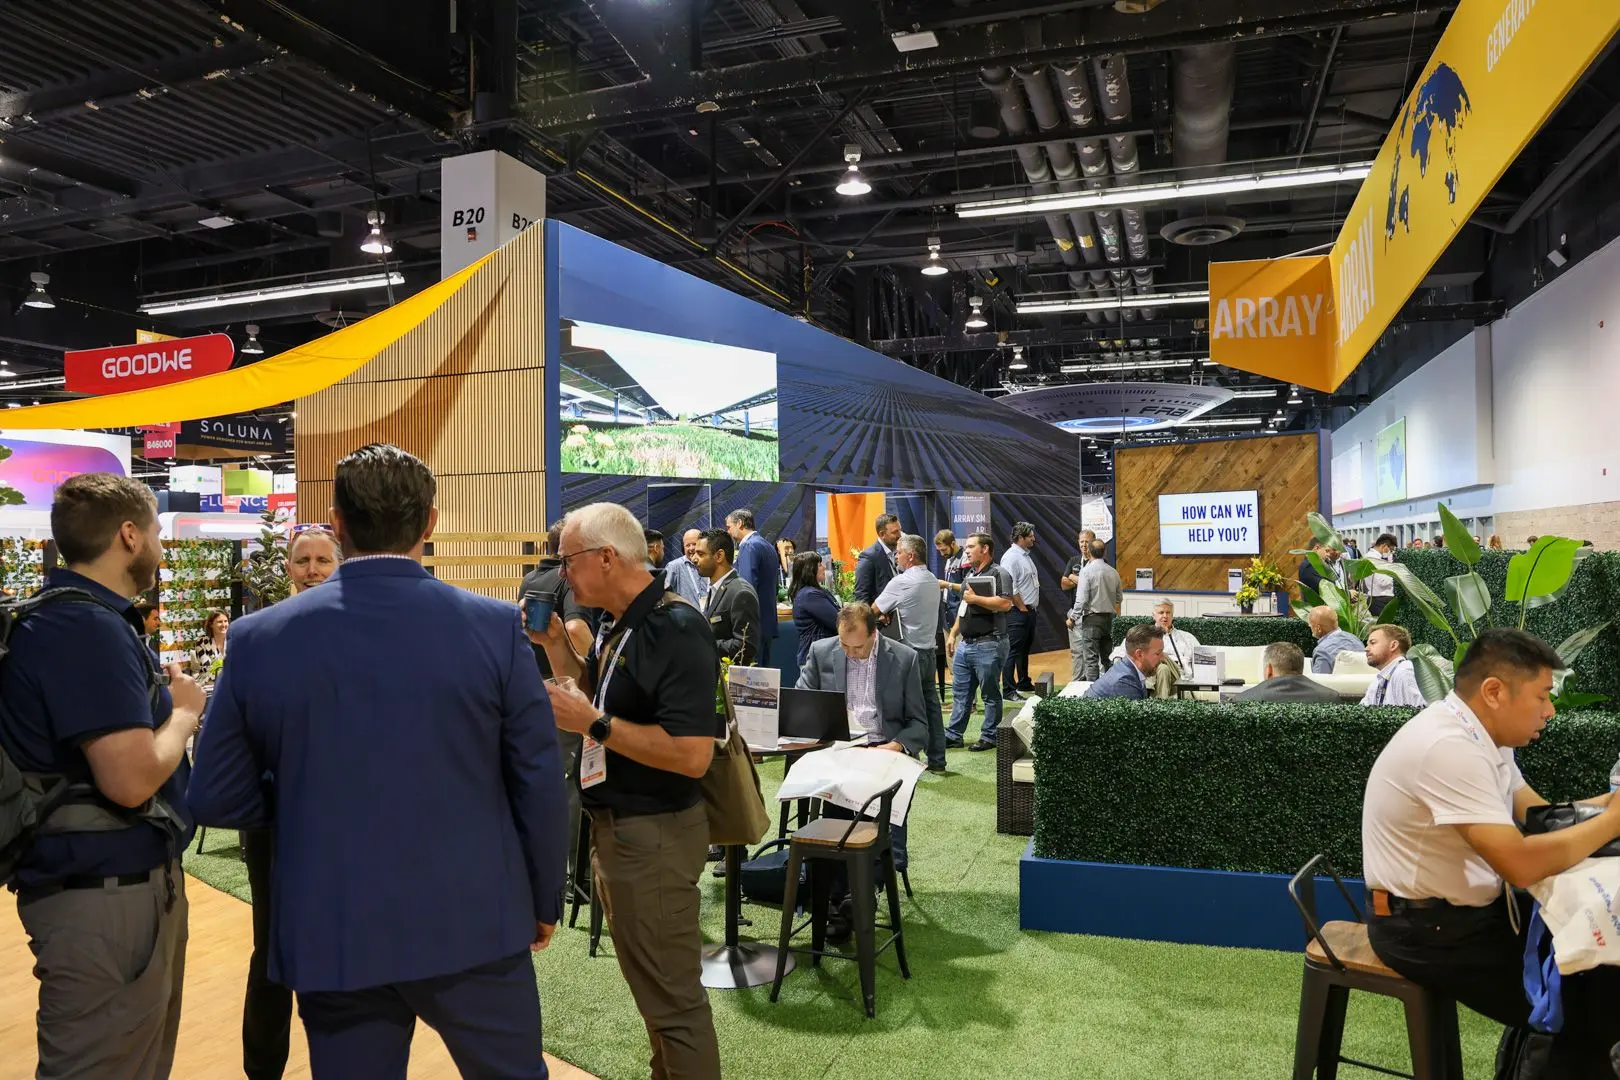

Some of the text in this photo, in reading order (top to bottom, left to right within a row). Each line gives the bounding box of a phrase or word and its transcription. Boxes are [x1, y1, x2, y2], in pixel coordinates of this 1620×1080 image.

[1487, 0, 1537, 72] GENERA
[452, 207, 485, 227] B20
[1338, 206, 1375, 348] ARRAY
[1212, 293, 1324, 340] ARRAY
[102, 348, 192, 379] GOODWE
[200, 495, 268, 507] FLNCE
[954, 514, 975, 523] ARRAY
[1182, 503, 1253, 520] HOW CAN WE
[1188, 526, 1247, 543] HELP YOU?
